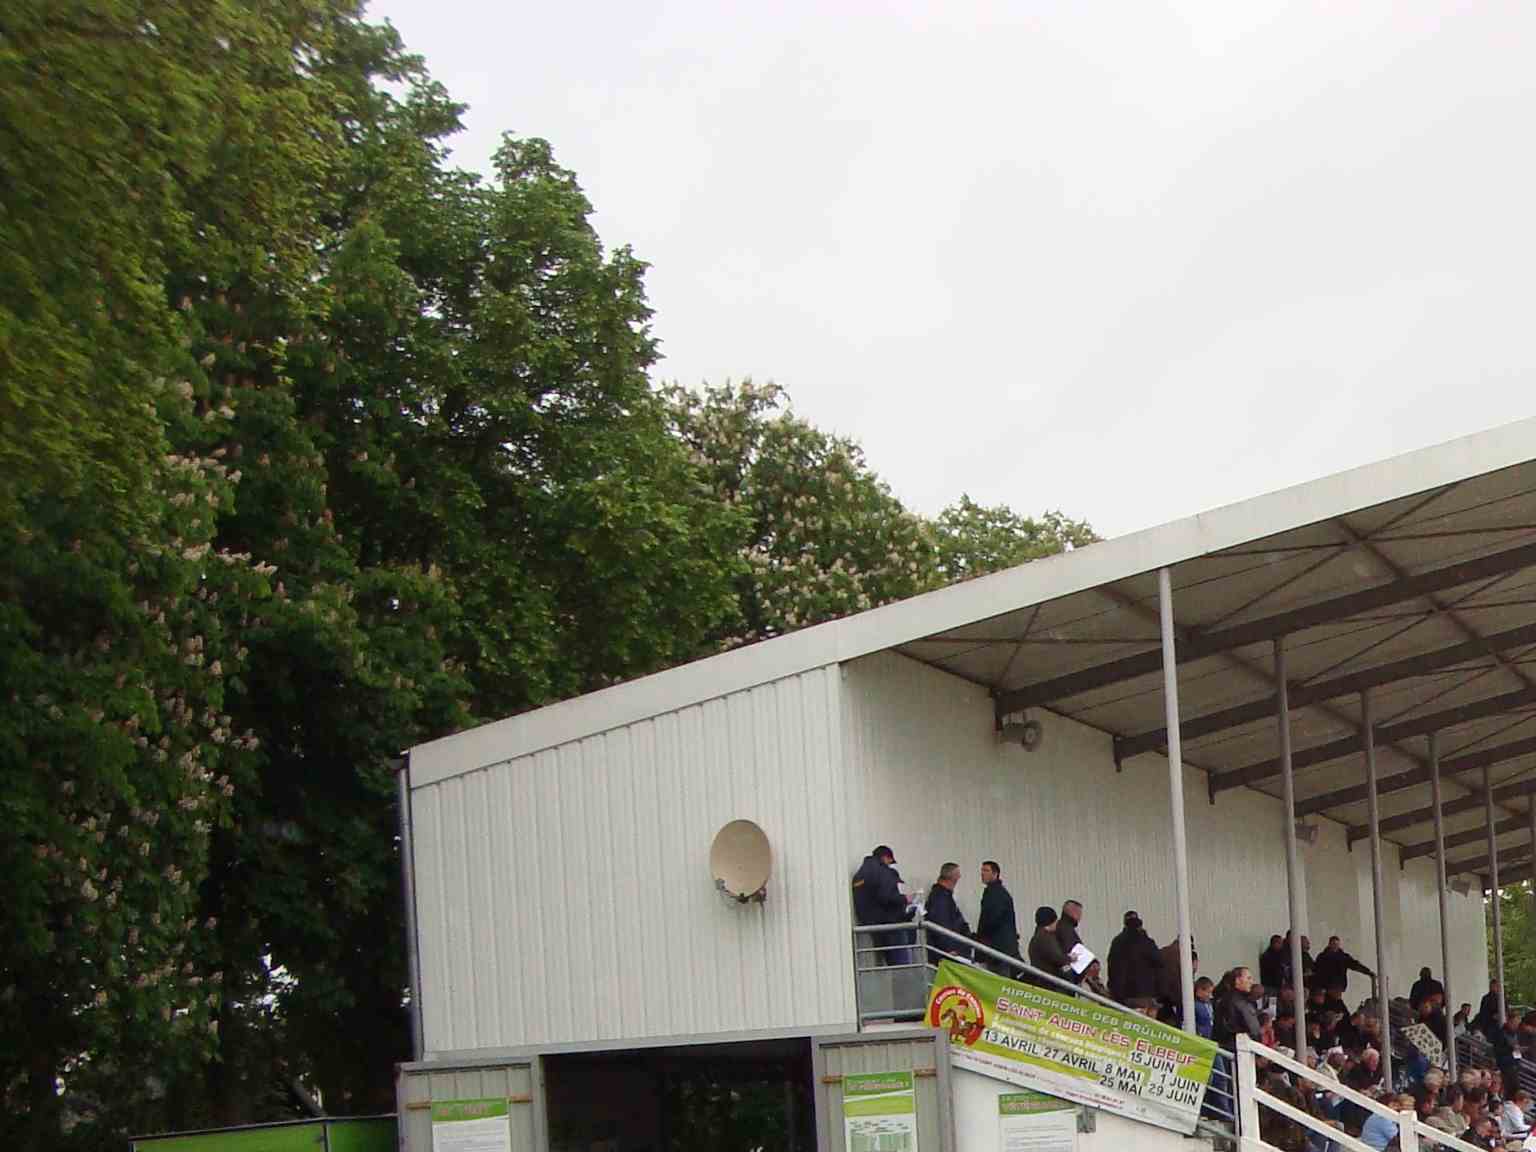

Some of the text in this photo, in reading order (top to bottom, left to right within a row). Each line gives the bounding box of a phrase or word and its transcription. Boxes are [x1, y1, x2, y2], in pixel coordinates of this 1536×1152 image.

[996, 997, 1046, 1022] SAINT
[1047, 1012, 1097, 1037] AUBIN
[1135, 1038, 1198, 1065] ELBEUF
[984, 1030, 1141, 1082] 13 AVRIL 27 AVRIL 8 MAI
[1130, 1052, 1175, 1073] 15 JUIN
[1099, 1075, 1143, 1097] 25 MAI
[1160, 1073, 1200, 1093] 1 JUIN
[1149, 1083, 1199, 1106] 29 JUIN
